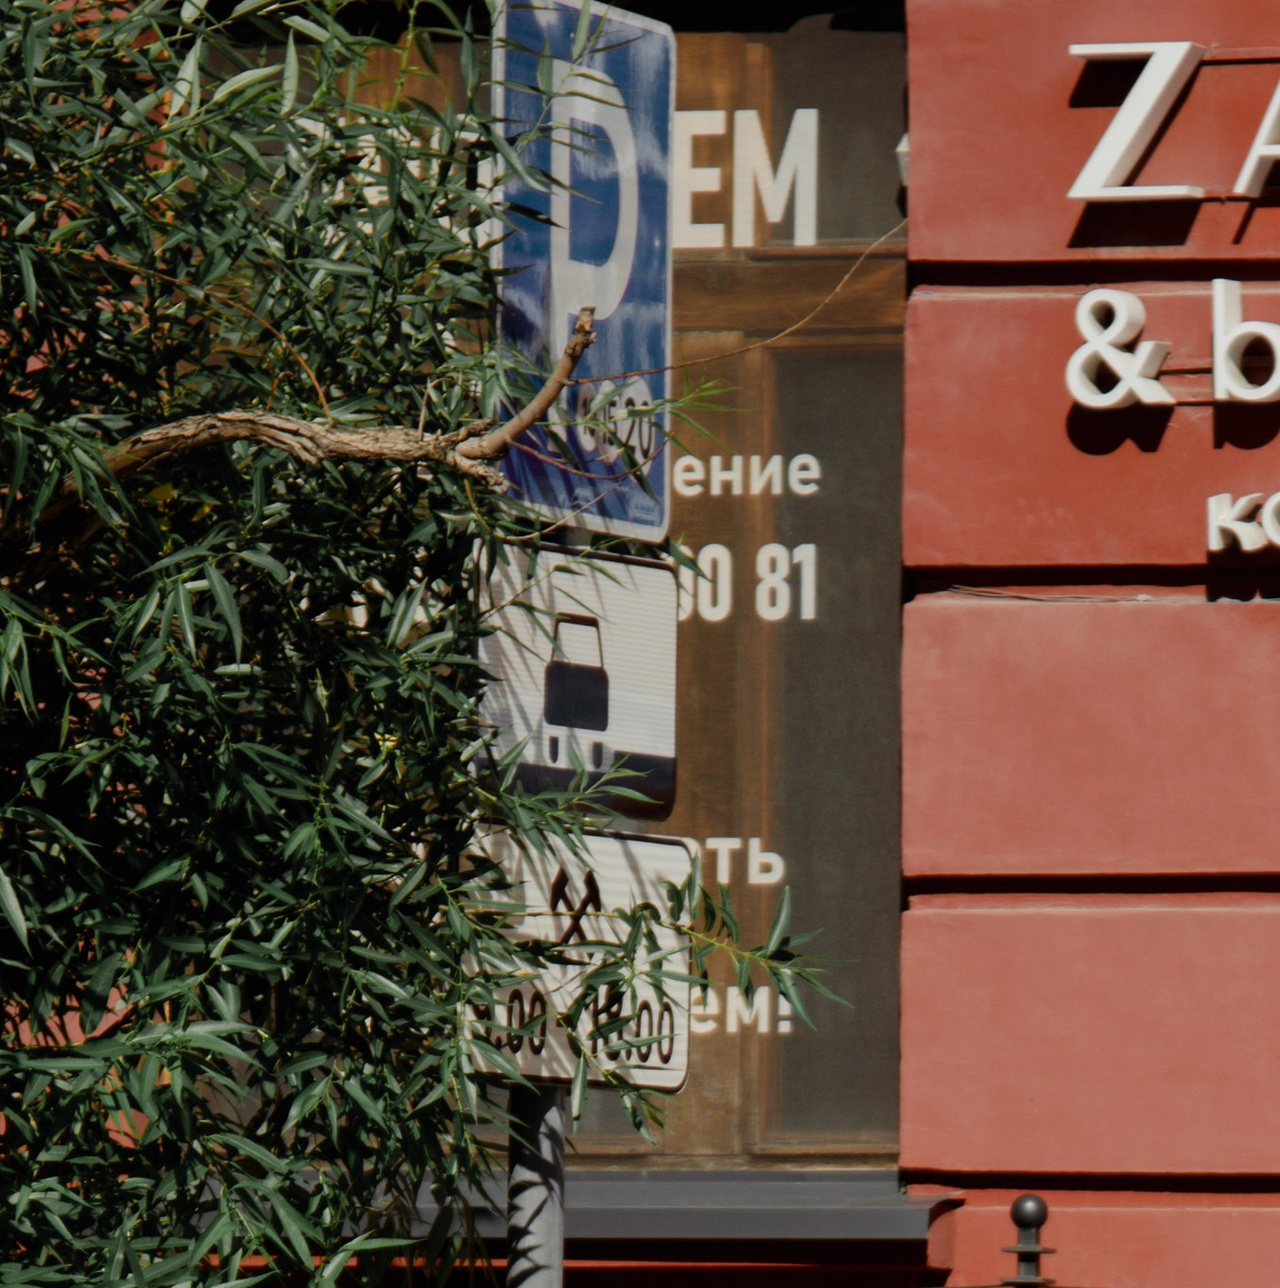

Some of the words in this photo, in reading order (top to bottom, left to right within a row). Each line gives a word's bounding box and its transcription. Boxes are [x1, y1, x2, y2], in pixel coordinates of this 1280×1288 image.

[671, 108, 818, 249] ЕМ
[1065, 288, 1177, 408] &
[672, 453, 822, 497] ение
[755, 542, 817, 621] 81
[690, 837, 786, 885] ть
